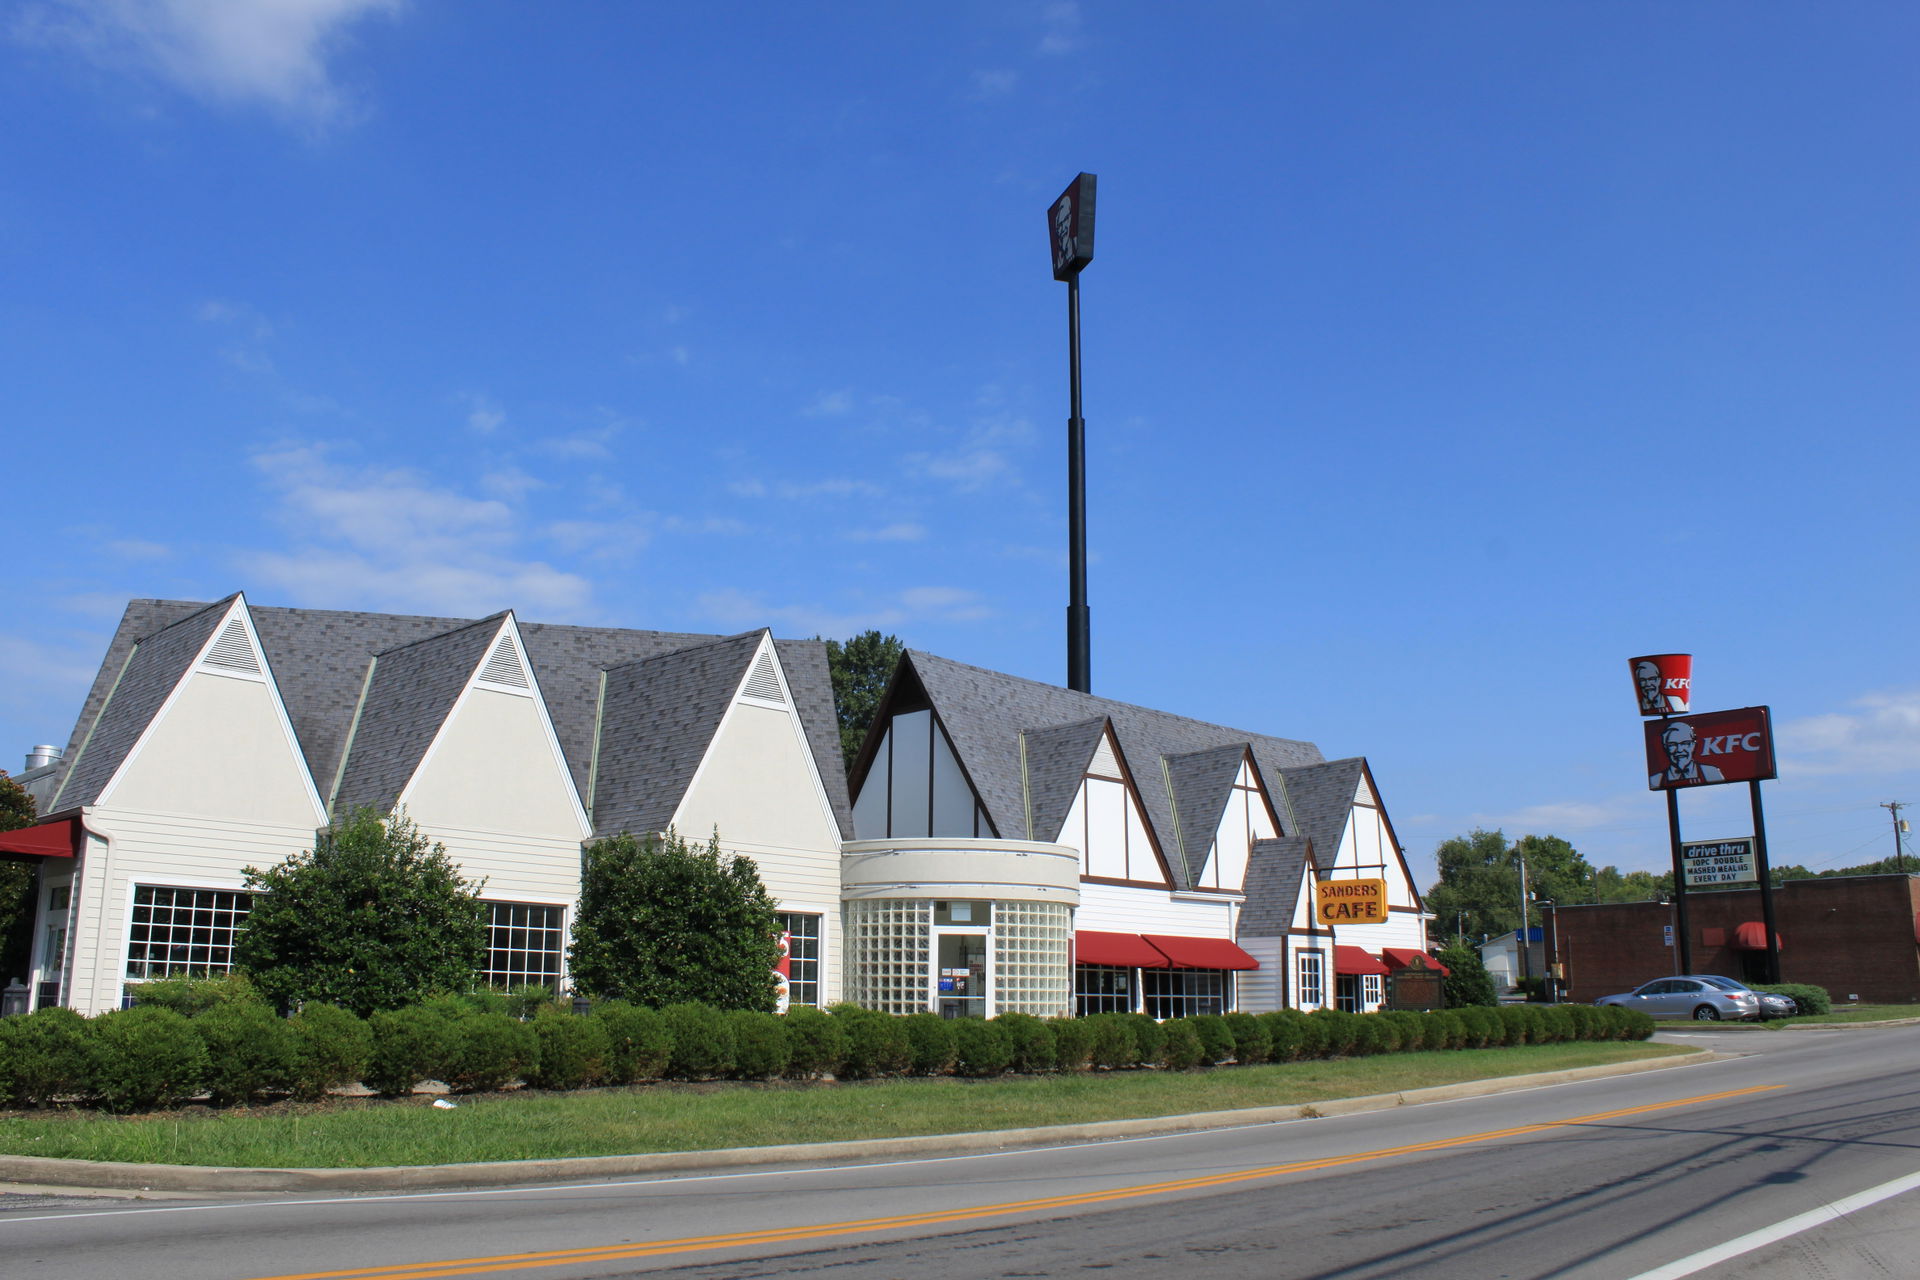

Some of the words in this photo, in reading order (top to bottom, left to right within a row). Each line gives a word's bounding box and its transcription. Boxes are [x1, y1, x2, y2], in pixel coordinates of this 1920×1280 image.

[1701, 732, 1761, 756] KFC
[1688, 846, 1717, 857] drive
[1720, 843, 1744, 854] thru
[1714, 856, 1744, 864] DOUBLE
[1687, 866, 1716, 875] MASHED
[1717, 864, 1738, 873] MEAL
[1694, 873, 1717, 883] EVERY
[1721, 873, 1737, 881] DAY
[1321, 884, 1378, 898] SANDERS
[1322, 902, 1376, 919] CAFE
